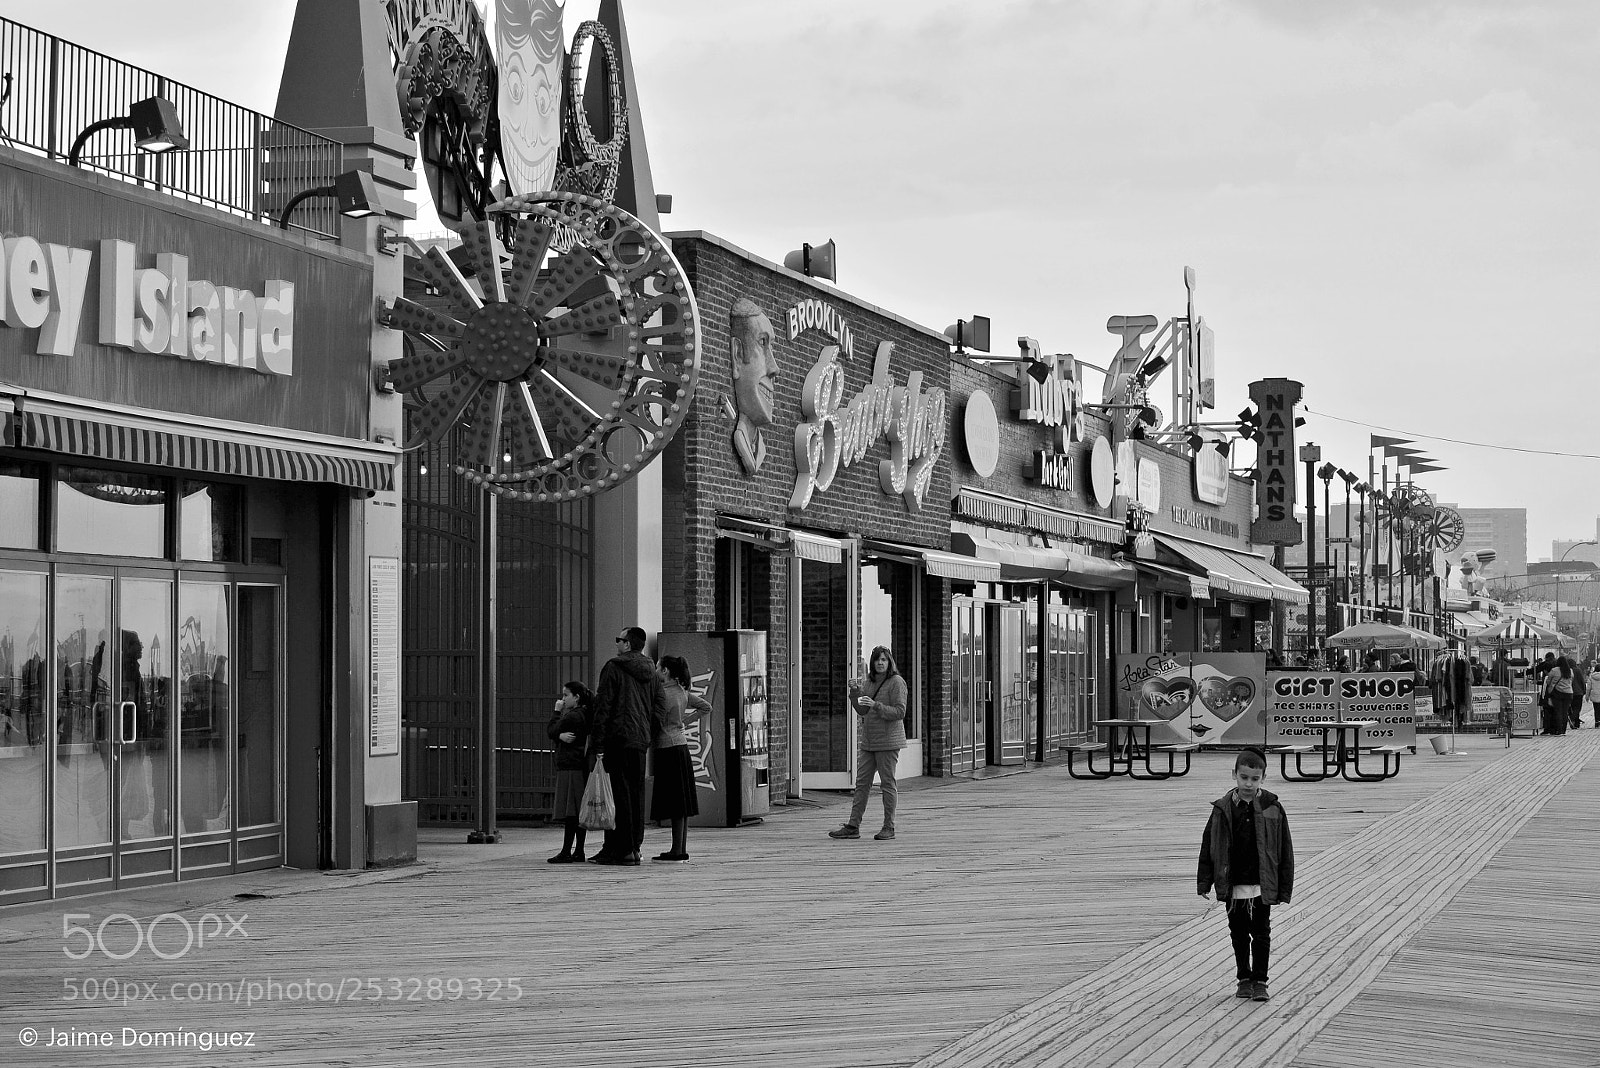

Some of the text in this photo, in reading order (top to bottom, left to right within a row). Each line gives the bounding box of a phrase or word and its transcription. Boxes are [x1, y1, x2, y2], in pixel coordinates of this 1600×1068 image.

[0, 231, 294, 376] ey Island
[786, 299, 854, 360] BROOKLYN
[1266, 394, 1286, 521] NATHANS
[1274, 677, 1414, 699] GIFT SHOP
[1349, 703, 1409, 711] SOUVENIRS
[1384, 716, 1413, 724] GEAR
[1366, 729, 1394, 737] TOYS
